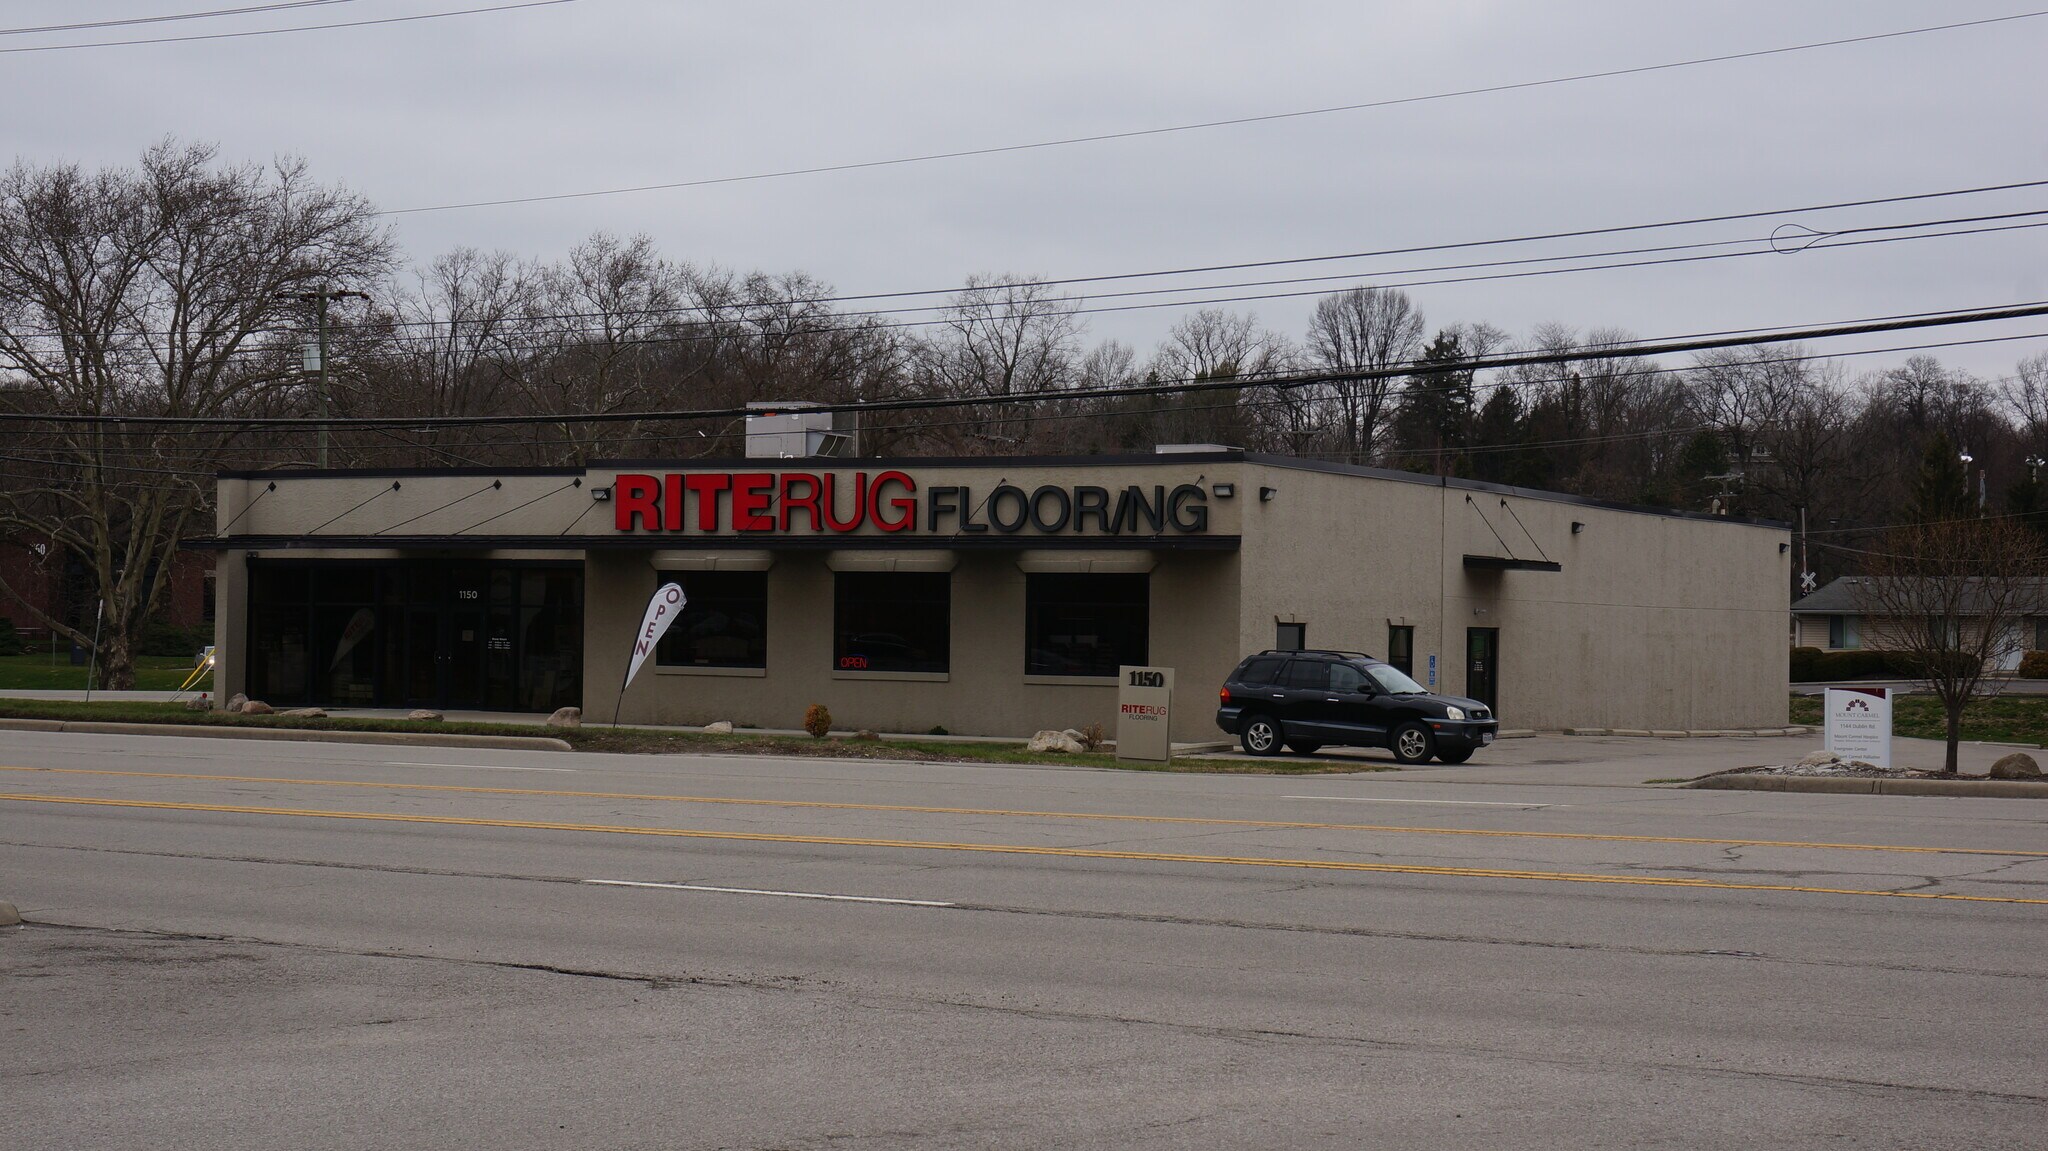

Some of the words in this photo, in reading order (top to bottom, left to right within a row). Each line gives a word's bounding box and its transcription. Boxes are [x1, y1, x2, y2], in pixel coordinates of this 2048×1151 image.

[615, 470, 919, 532] RITERUG
[927, 484, 1209, 534] FLOORING
[459, 590, 478, 599] 1150
[635, 588, 680, 657] OPEN
[841, 657, 867, 668] OPEN
[1128, 670, 1164, 688] 1150
[1121, 704, 1166, 716] RITERUG
